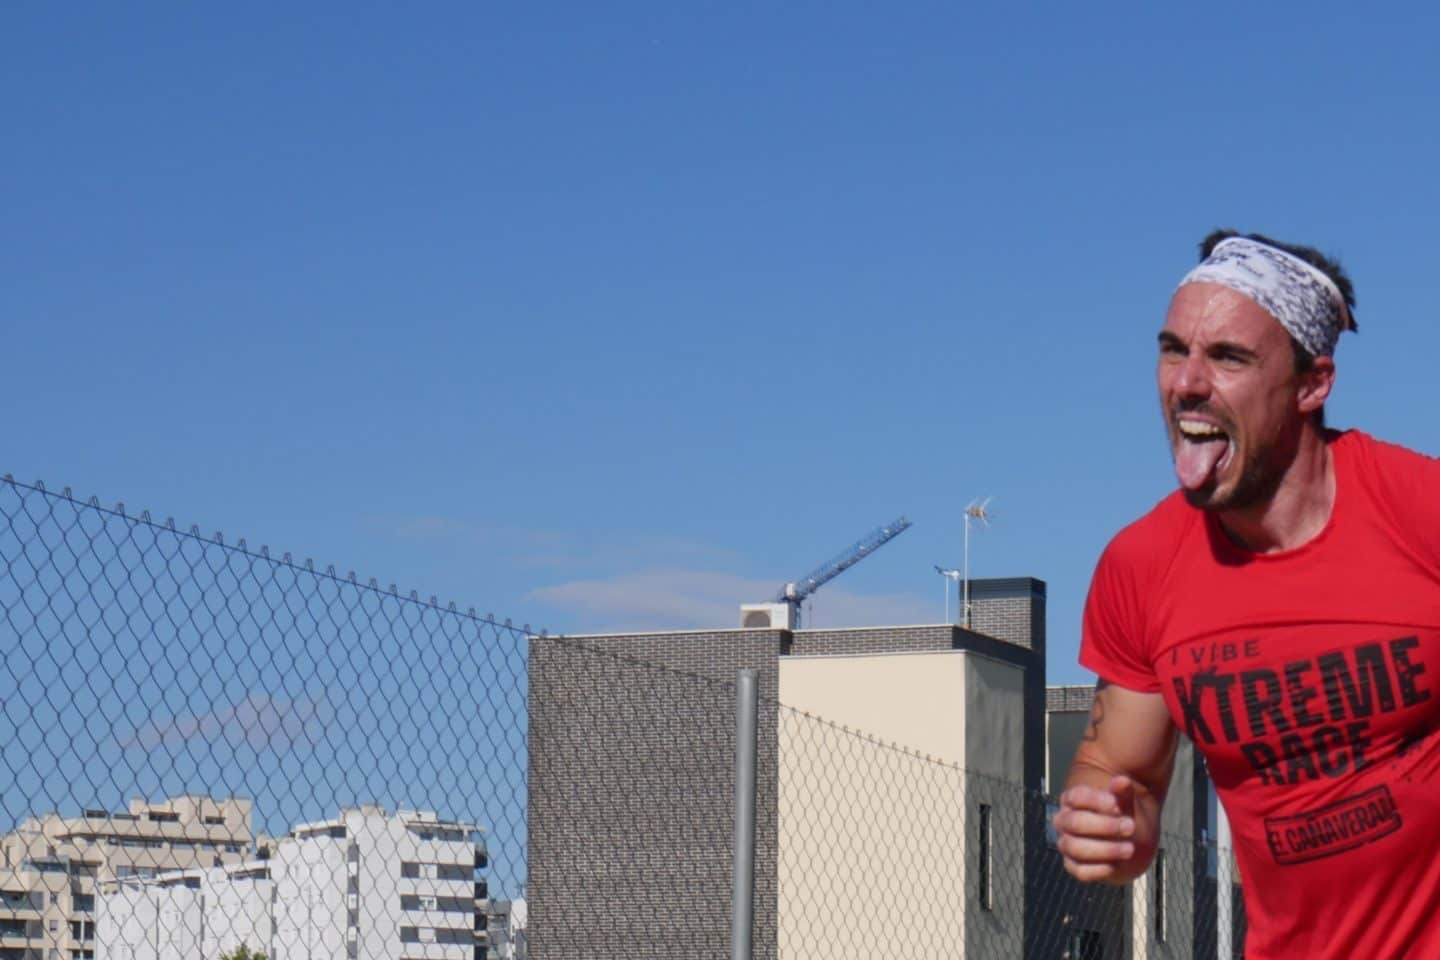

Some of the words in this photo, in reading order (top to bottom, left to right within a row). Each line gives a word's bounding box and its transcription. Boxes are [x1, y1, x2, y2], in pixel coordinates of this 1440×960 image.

[1191, 640, 1261, 664] VIBE
[1171, 636, 1430, 745] XTREME
[1241, 721, 1374, 786] RACE
